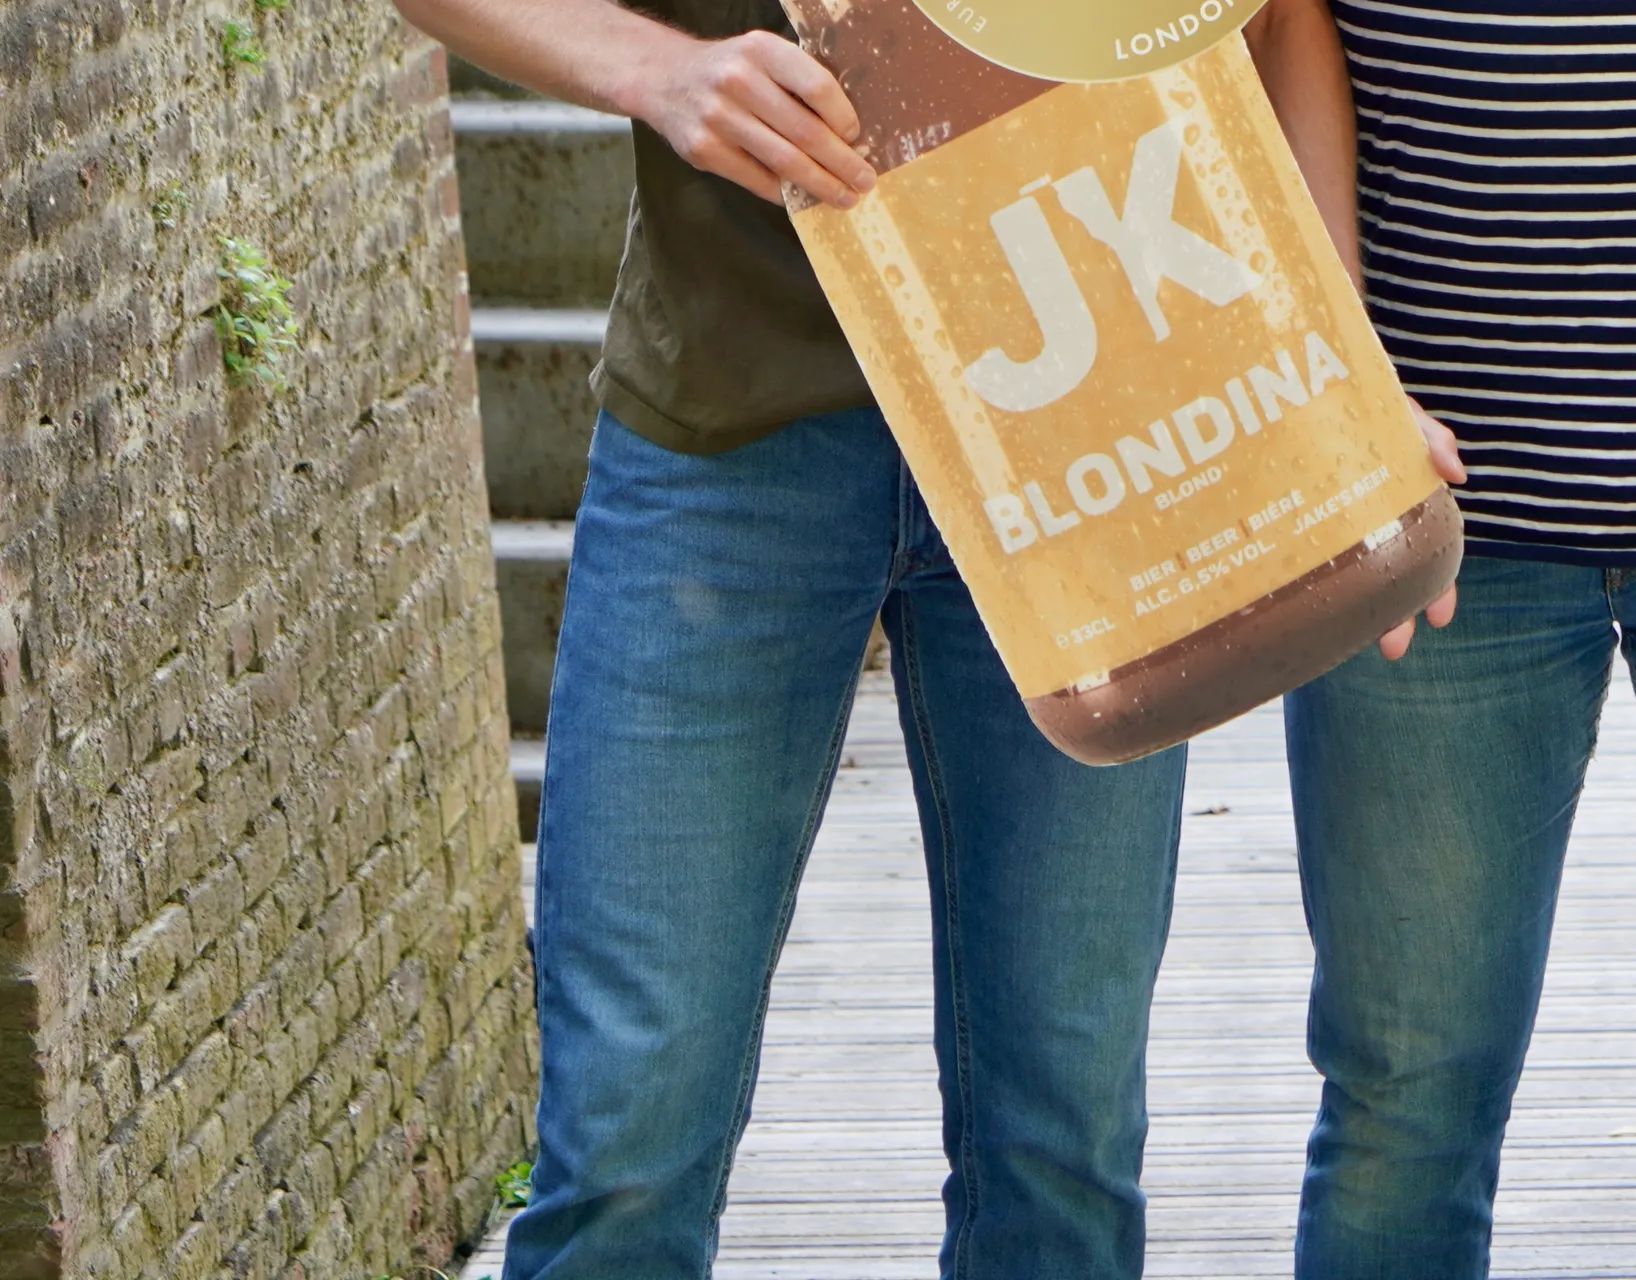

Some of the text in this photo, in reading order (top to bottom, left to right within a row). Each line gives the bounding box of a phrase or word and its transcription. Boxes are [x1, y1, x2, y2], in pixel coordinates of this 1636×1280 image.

[964, 119, 1264, 413] JK
[981, 331, 1349, 556] BLONDINA
[1155, 466, 1222, 510] BLOND
[1129, 489, 1305, 592] BIER BEER BIÈRE
[1134, 465, 1391, 617] ALC. 6,5% VOL. JAKE'S BEER
[1069, 617, 1116, 644] 33CL
